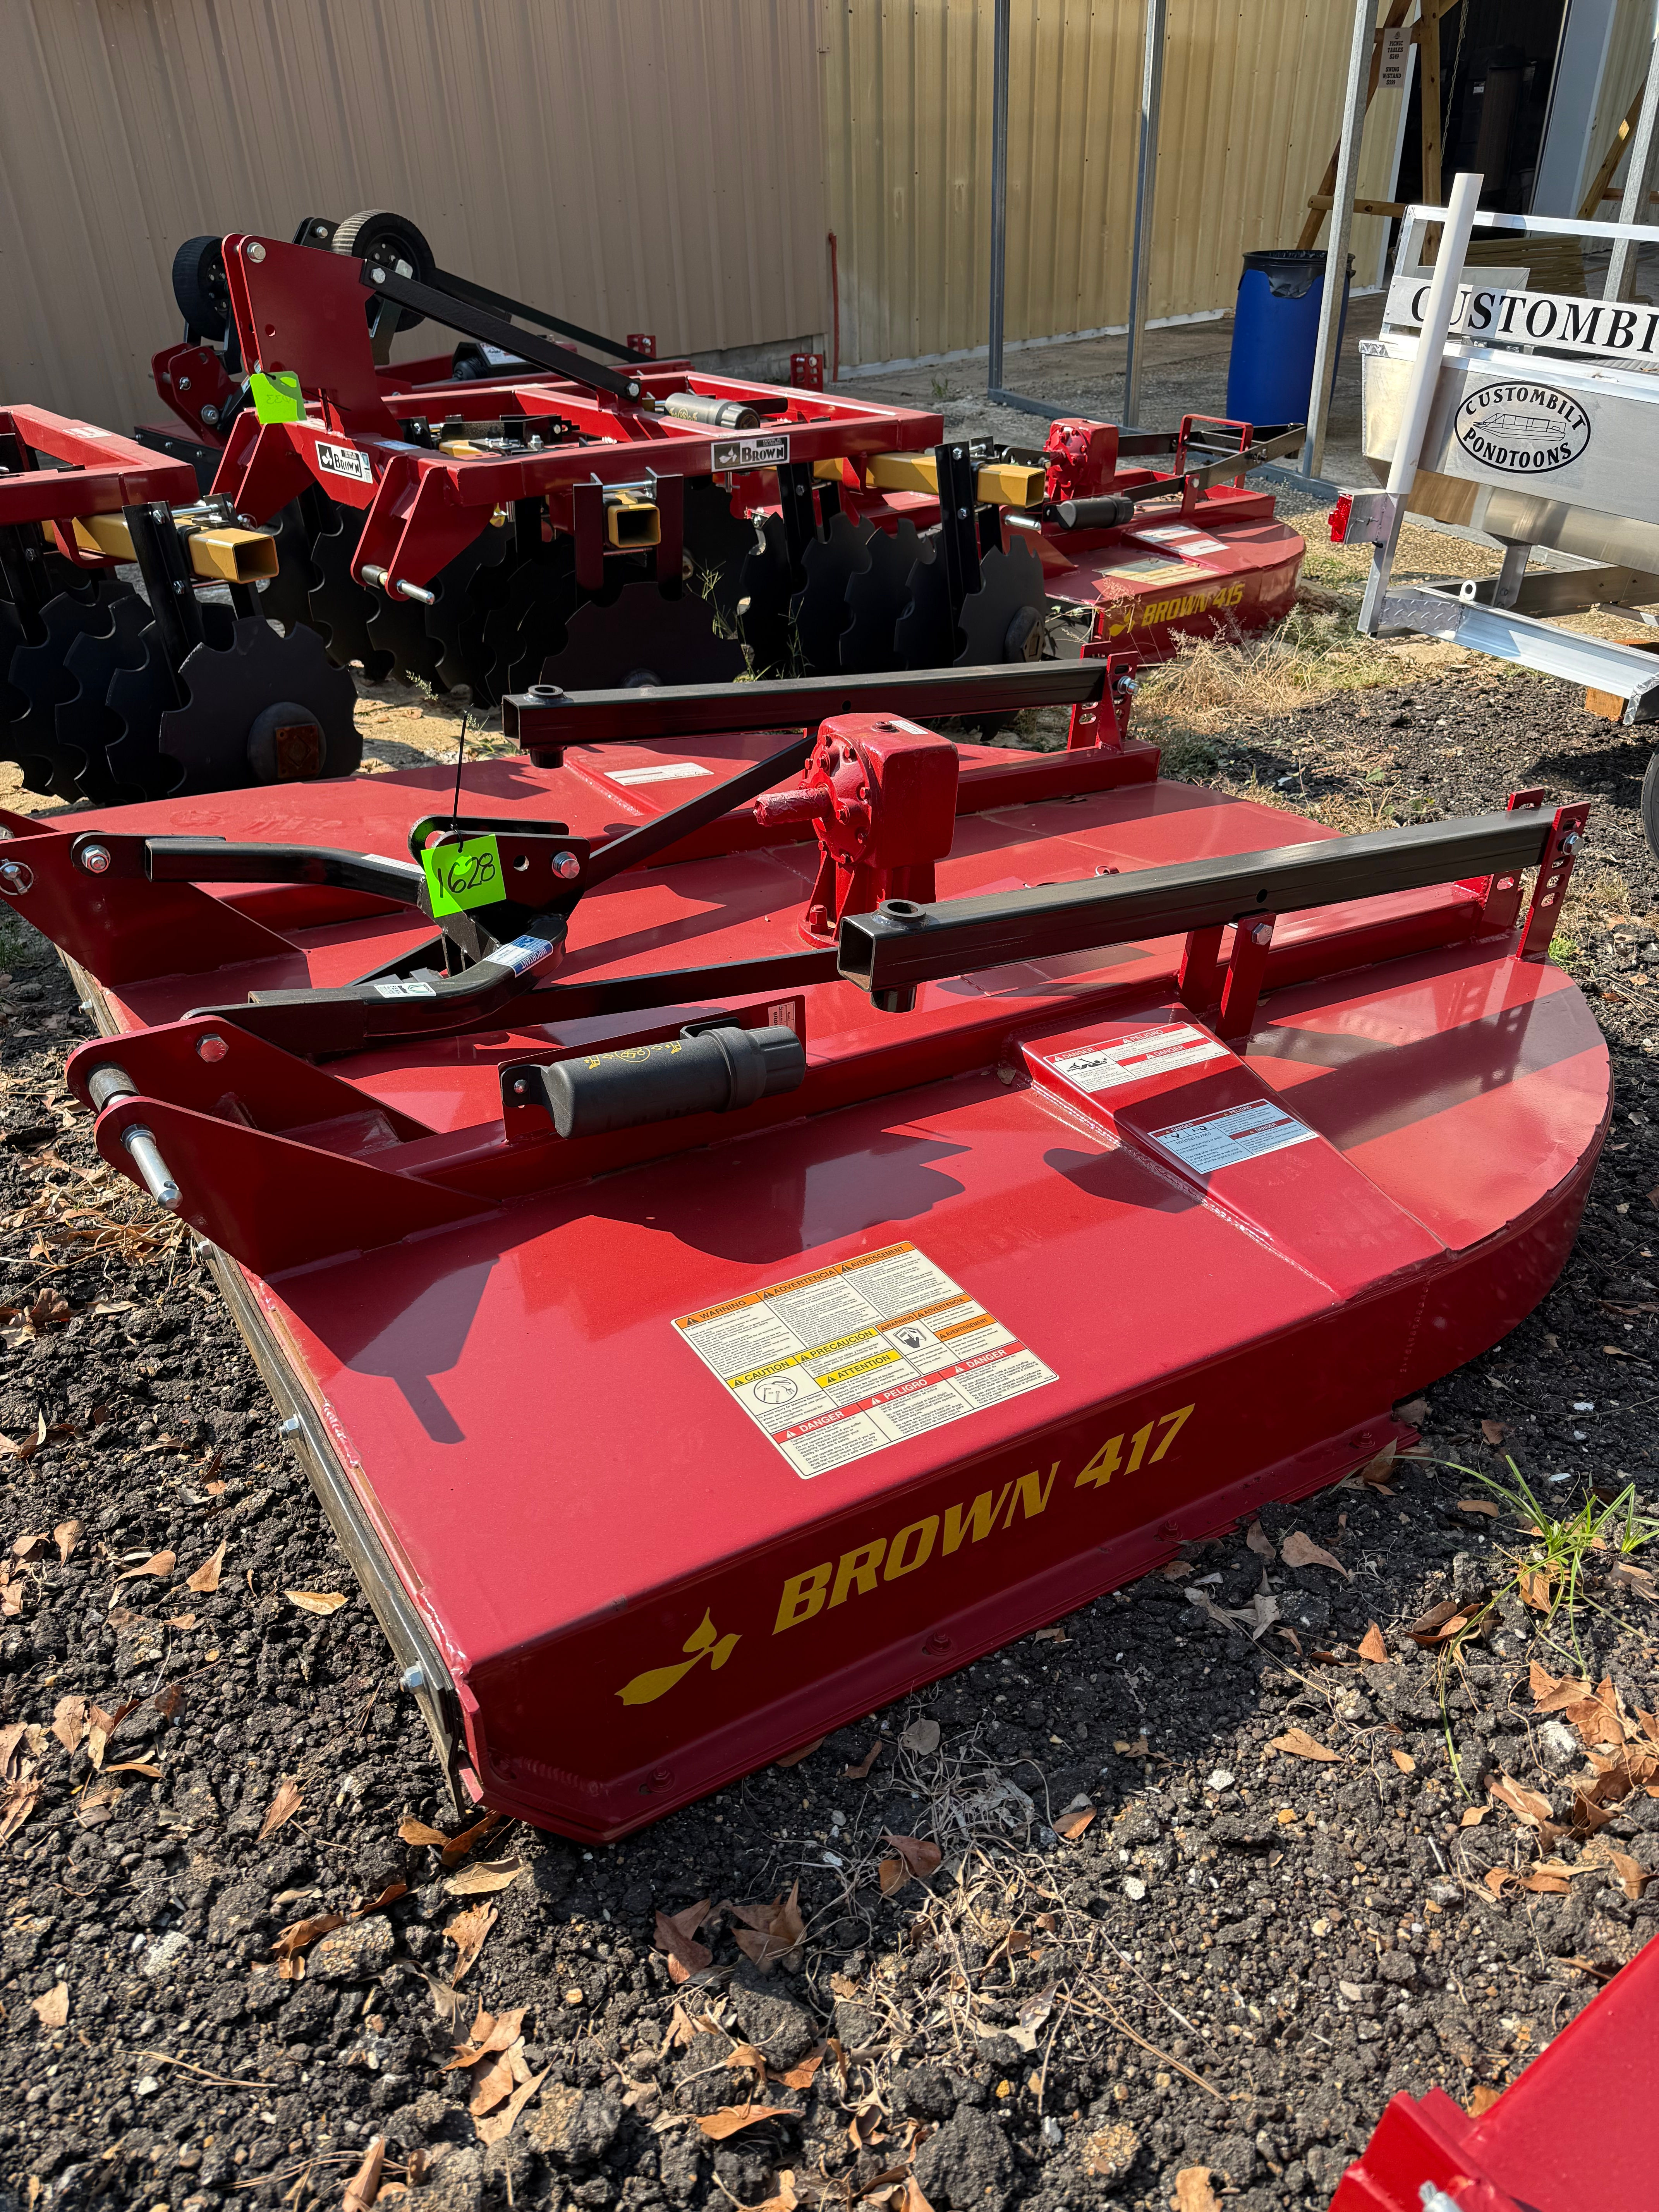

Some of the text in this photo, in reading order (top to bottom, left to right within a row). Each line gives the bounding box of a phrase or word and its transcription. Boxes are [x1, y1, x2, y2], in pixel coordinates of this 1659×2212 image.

[1466, 387, 1586, 430] CUSTOMBILT
[1463, 427, 1572, 468] PONDTOONS
[1141, 584, 1245, 627] BROWN 415
[436, 853, 496, 899] 1628
[520, 947, 547, 969] IMPORTANT
[1128, 1029, 1165, 1041] PELIGRO
[1061, 1047, 1096, 1059] DANGER
[1152, 1045, 1186, 1056] DANGER
[1228, 1105, 1253, 1114] PELIGRO
[1170, 1123, 1195, 1132] DANGER
[1254, 1123, 1278, 1132] DANGER
[849, 1246, 905, 1268] AVERTISSEMENT
[772, 1269, 836, 1294] ADVERTENCIA
[699, 1300, 747, 1319] WARNING
[922, 1297, 965, 1315] ADVERTENCIA
[884, 1315, 915, 1329] WARNING
[944, 1317, 989, 1337] AVERTISSEMENT
[808, 1329, 874, 1357] PRECAUCIÓN
[835, 1354, 892, 1378] ATTENTION
[965, 1348, 1008, 1368] DANGER
[743, 1361, 790, 1381] CAUTION
[882, 1378, 929, 1400] PELIGRO
[798, 1410, 845, 1432] DANGER
[772, 1403, 1195, 1636] BROWN 417
